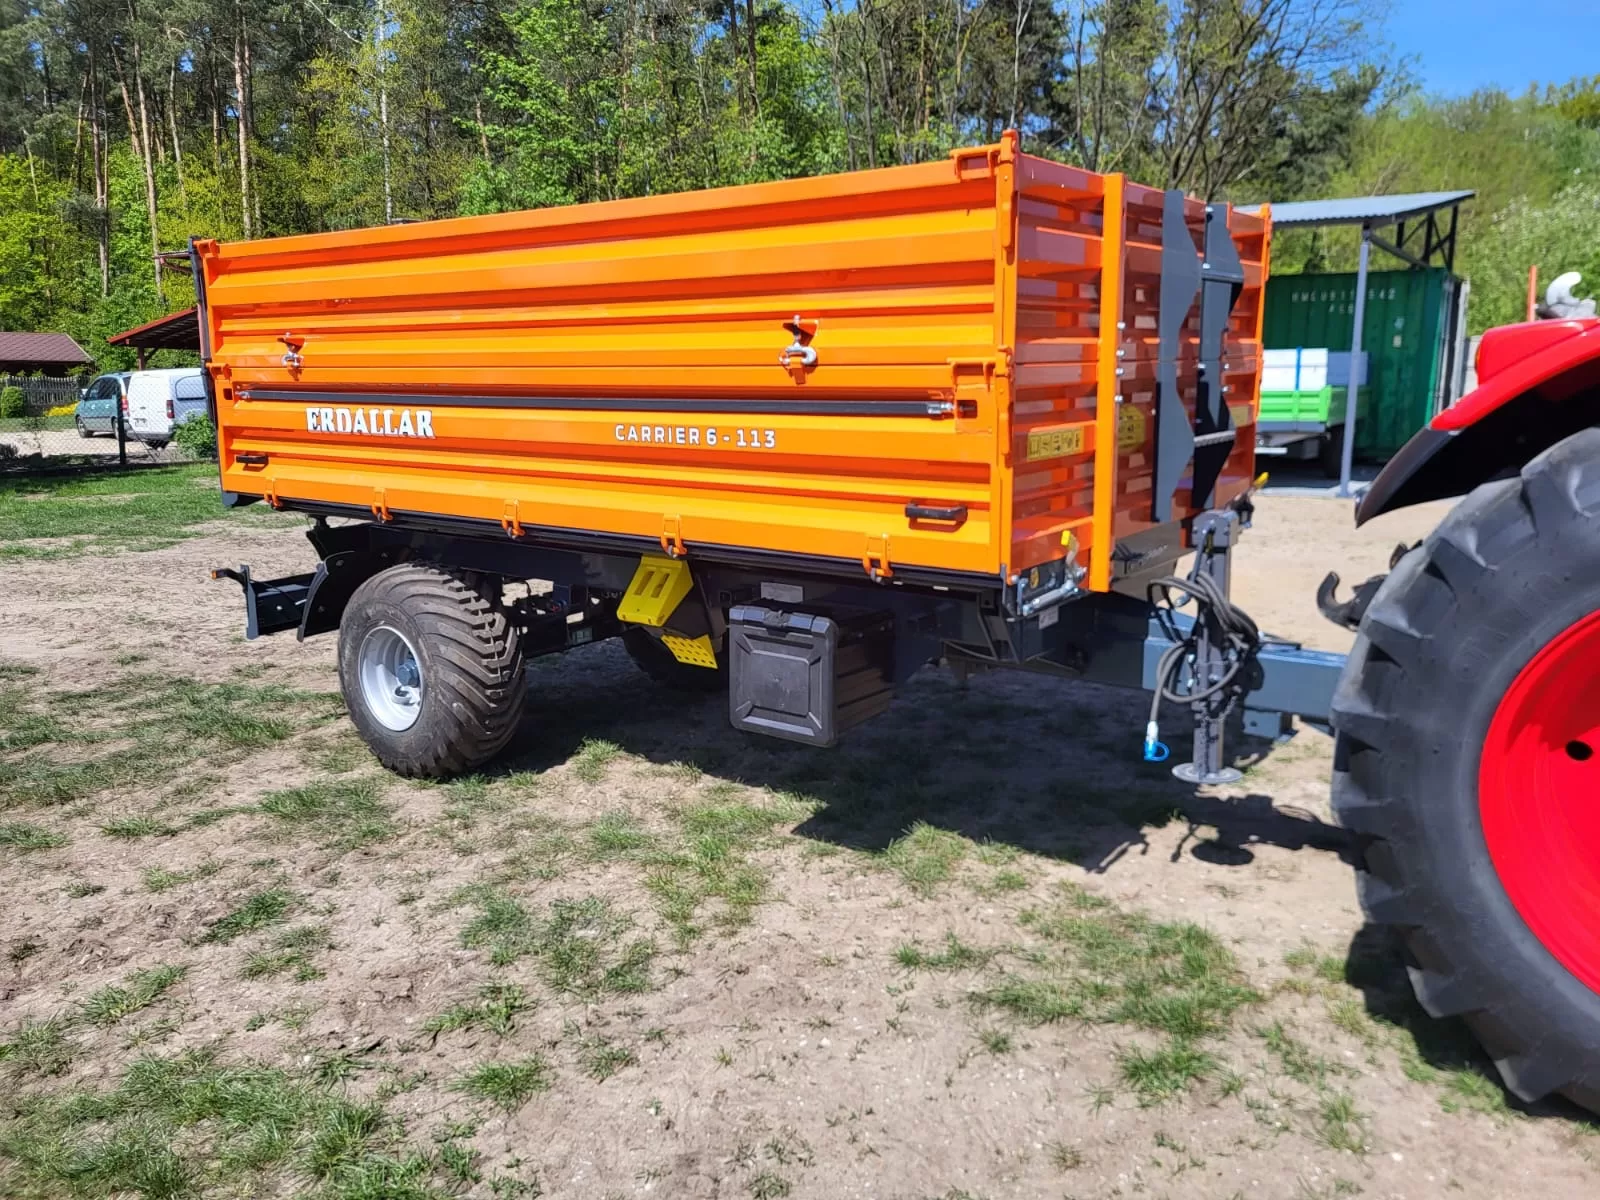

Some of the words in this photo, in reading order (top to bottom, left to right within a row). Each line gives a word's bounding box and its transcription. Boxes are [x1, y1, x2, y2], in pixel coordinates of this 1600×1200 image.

[305, 407, 436, 439] ERDALLAR
[614, 423, 701, 446] CARRIER
[736, 428, 776, 449] 113
